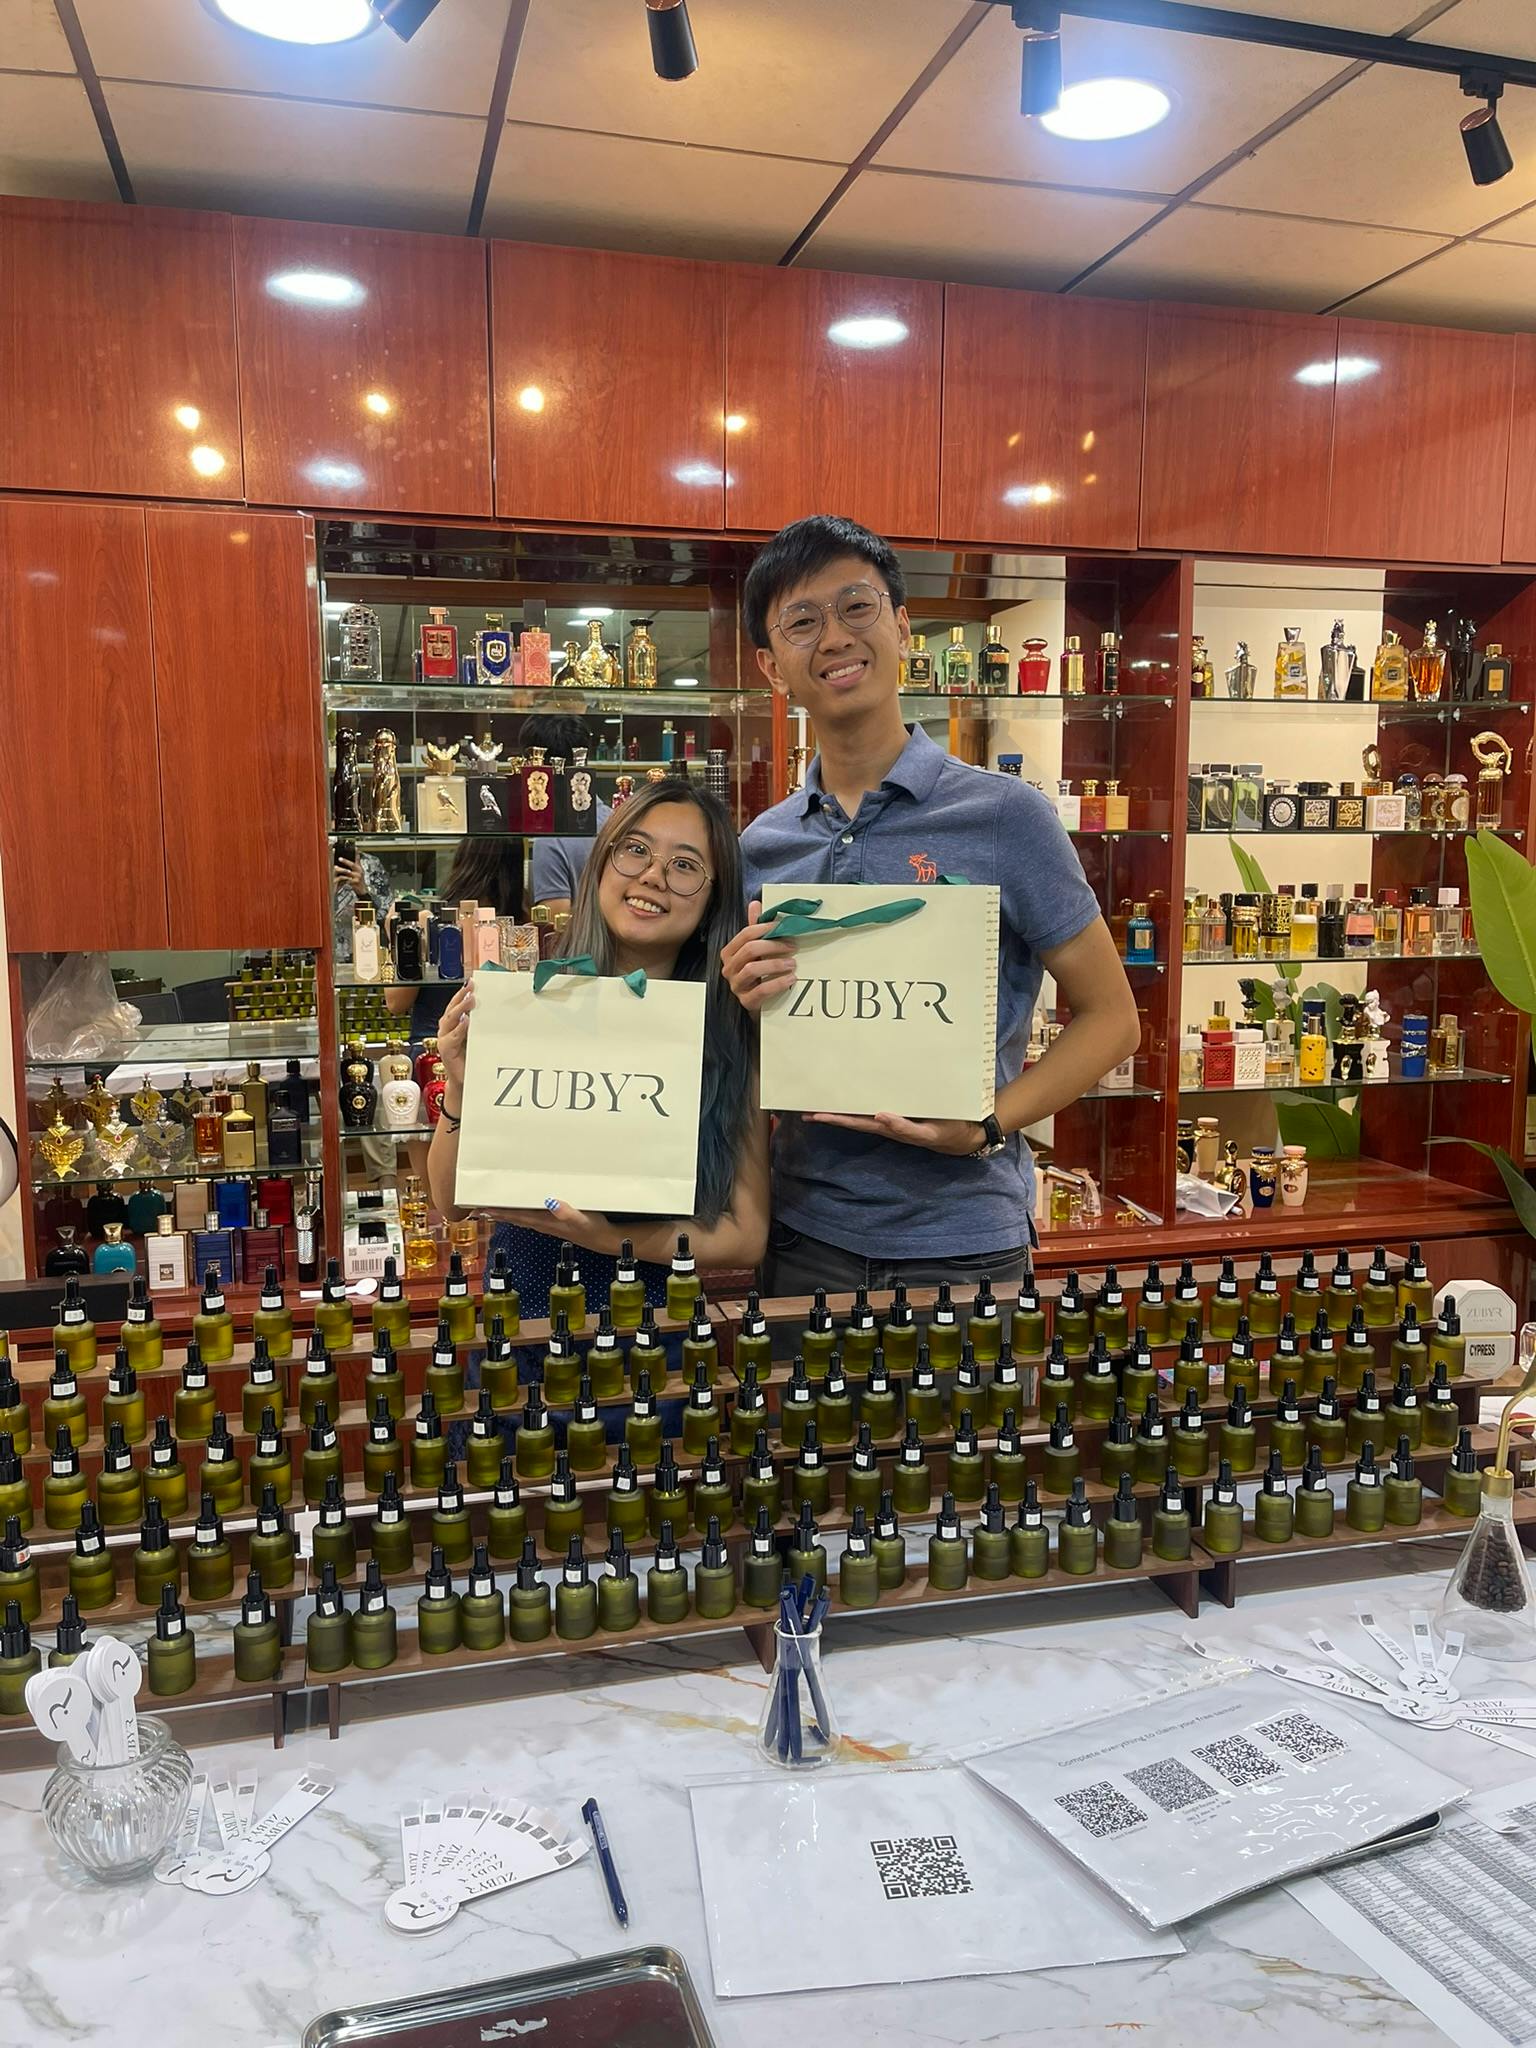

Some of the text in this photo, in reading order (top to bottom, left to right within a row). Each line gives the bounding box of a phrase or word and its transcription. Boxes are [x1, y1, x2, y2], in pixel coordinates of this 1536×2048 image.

[787, 977, 954, 1025] ZUBYR
[493, 1066, 670, 1118] ZUBYR
[1466, 1307, 1503, 1318] ZUBYR
[1469, 1344, 1496, 1357] CYPRESS
[1058, 1751, 1100, 1767] Complete
[1102, 1735, 1145, 1752] everything
[1156, 1725, 1178, 1736] claim
[1178, 1719, 1196, 1730] your
[465, 1871, 518, 1895] ZUBYR
